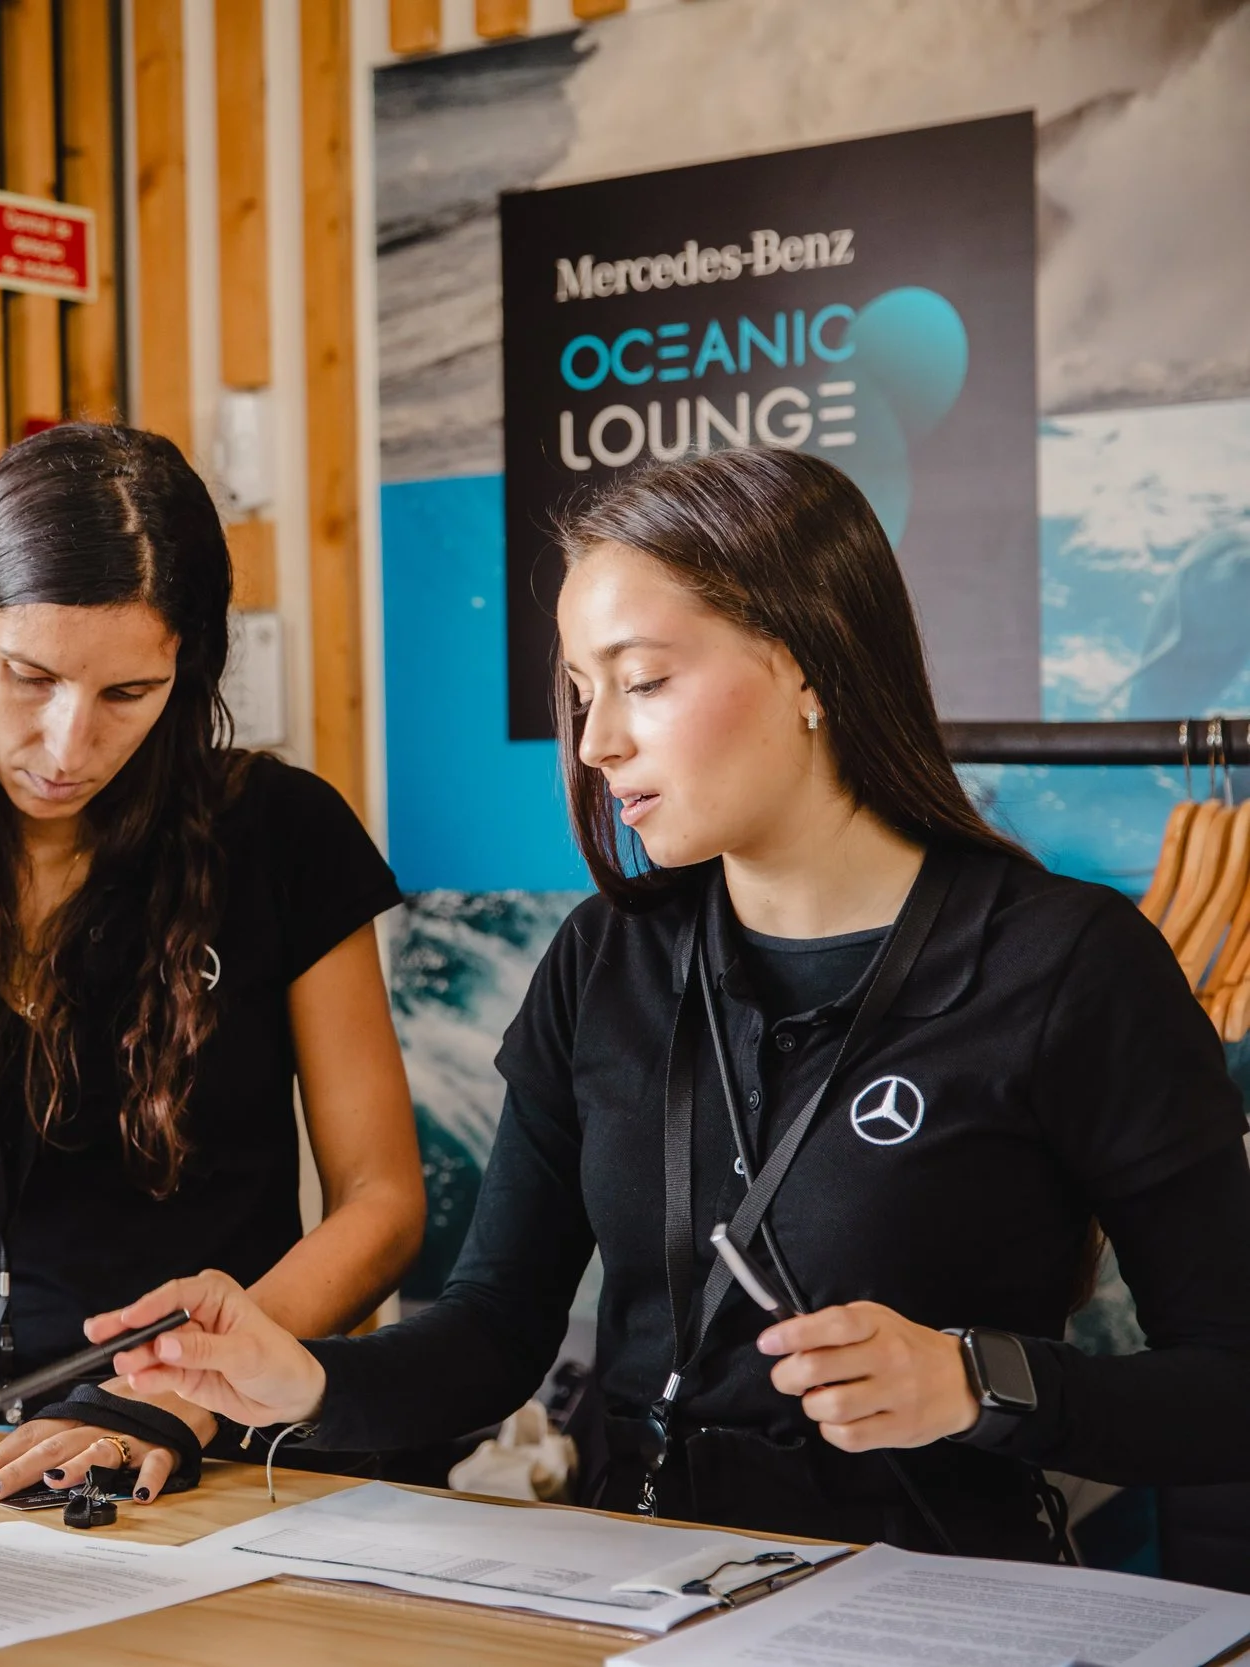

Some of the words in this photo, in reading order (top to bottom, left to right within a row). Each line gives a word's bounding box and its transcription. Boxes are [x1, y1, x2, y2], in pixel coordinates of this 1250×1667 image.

[555, 229, 855, 302] Mercedes-Benz
[560, 303, 857, 391] OCEANIC
[559, 381, 857, 472] LOUNGE
